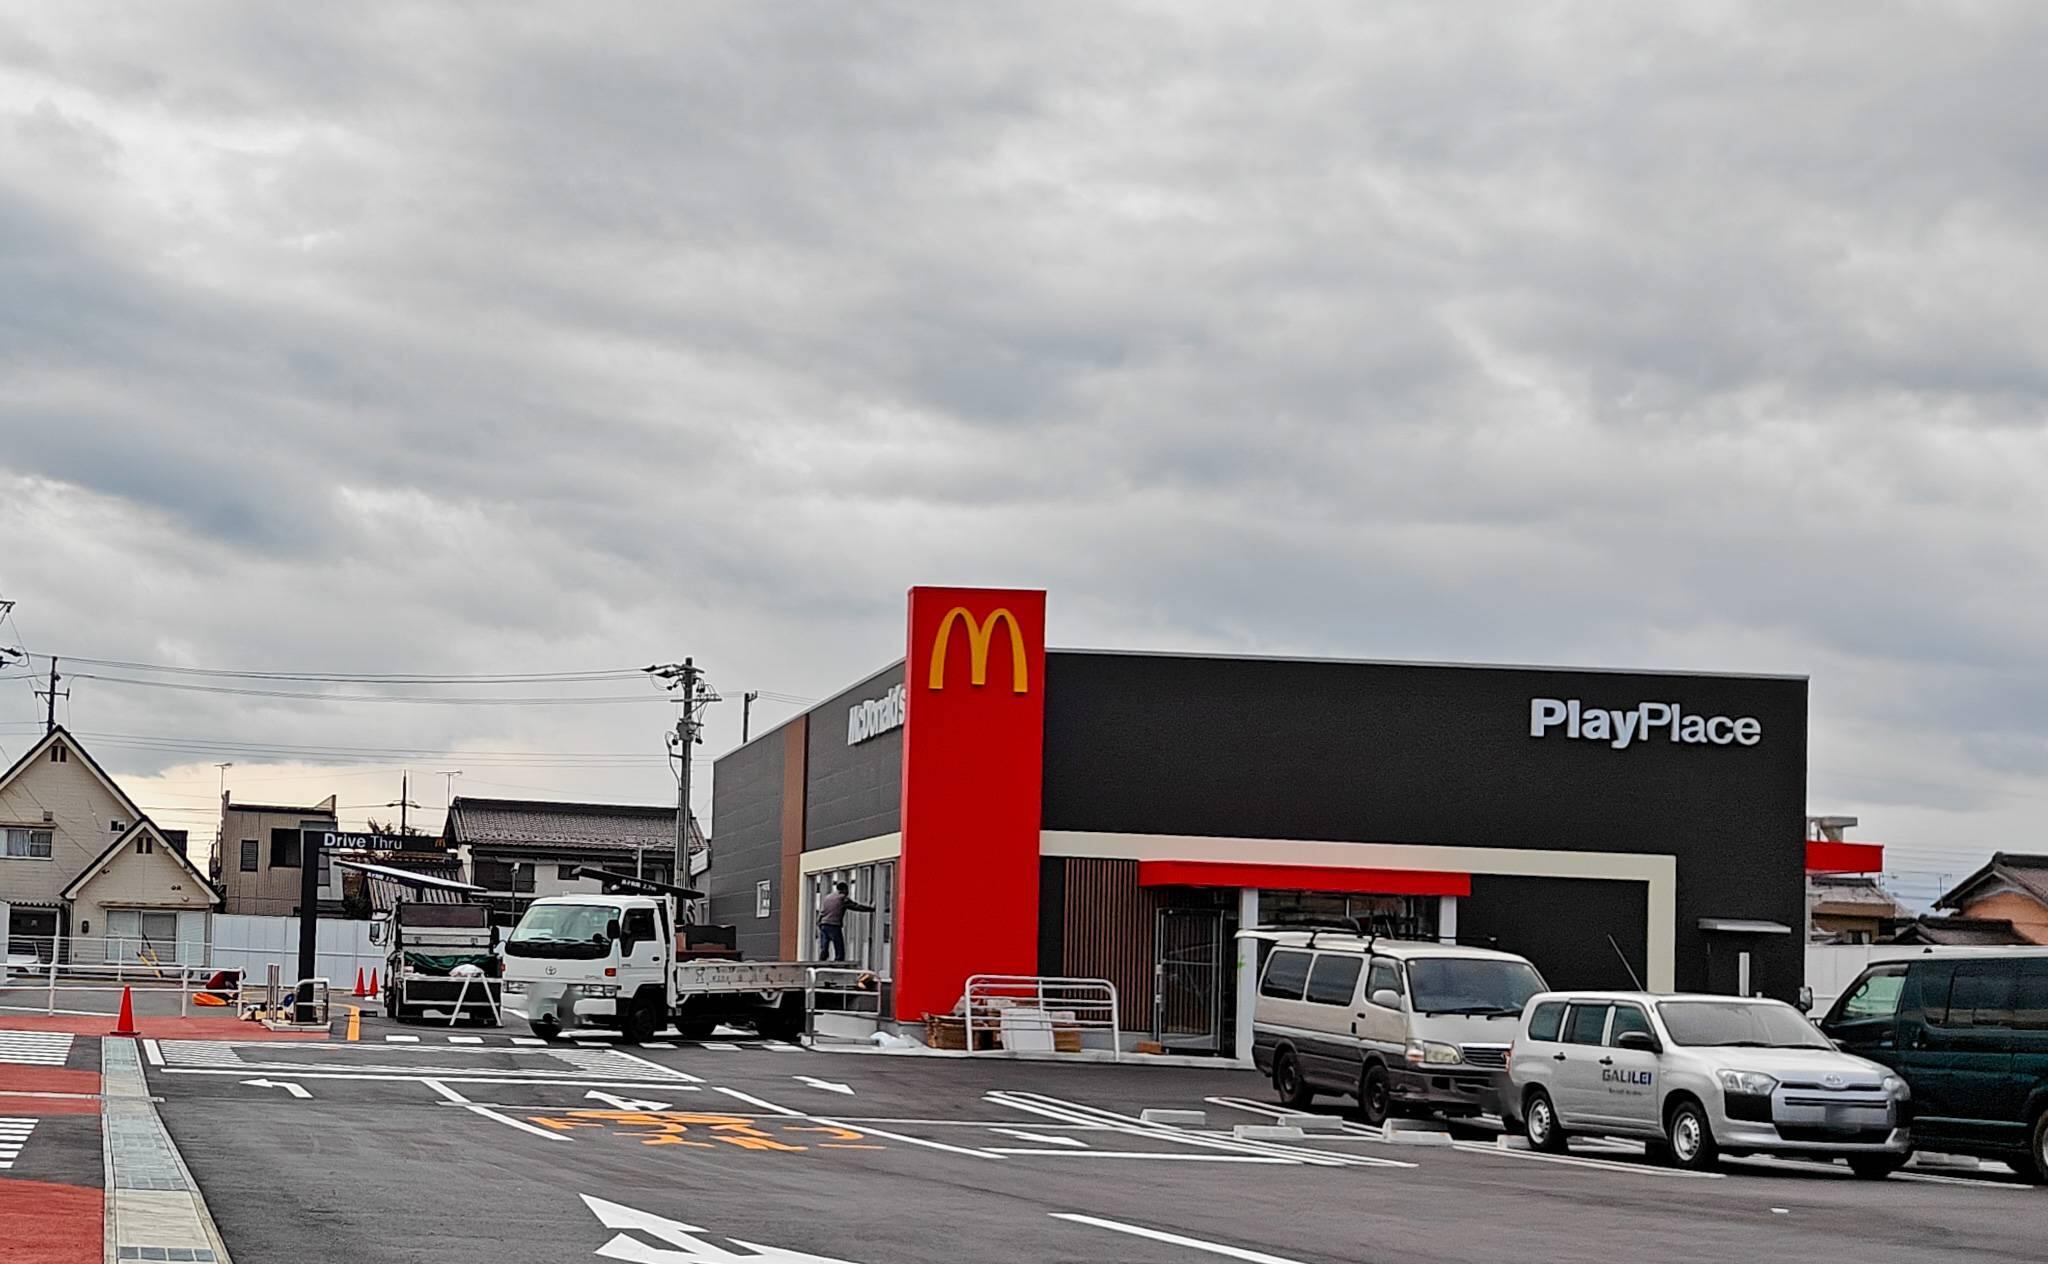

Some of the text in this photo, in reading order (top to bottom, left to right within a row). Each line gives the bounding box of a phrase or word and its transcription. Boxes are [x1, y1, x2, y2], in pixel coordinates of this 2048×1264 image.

[1530, 698, 1761, 749] PlayPlace
[324, 833, 402, 850] Drive Thru
[1602, 1069, 1652, 1085] GALILEI
